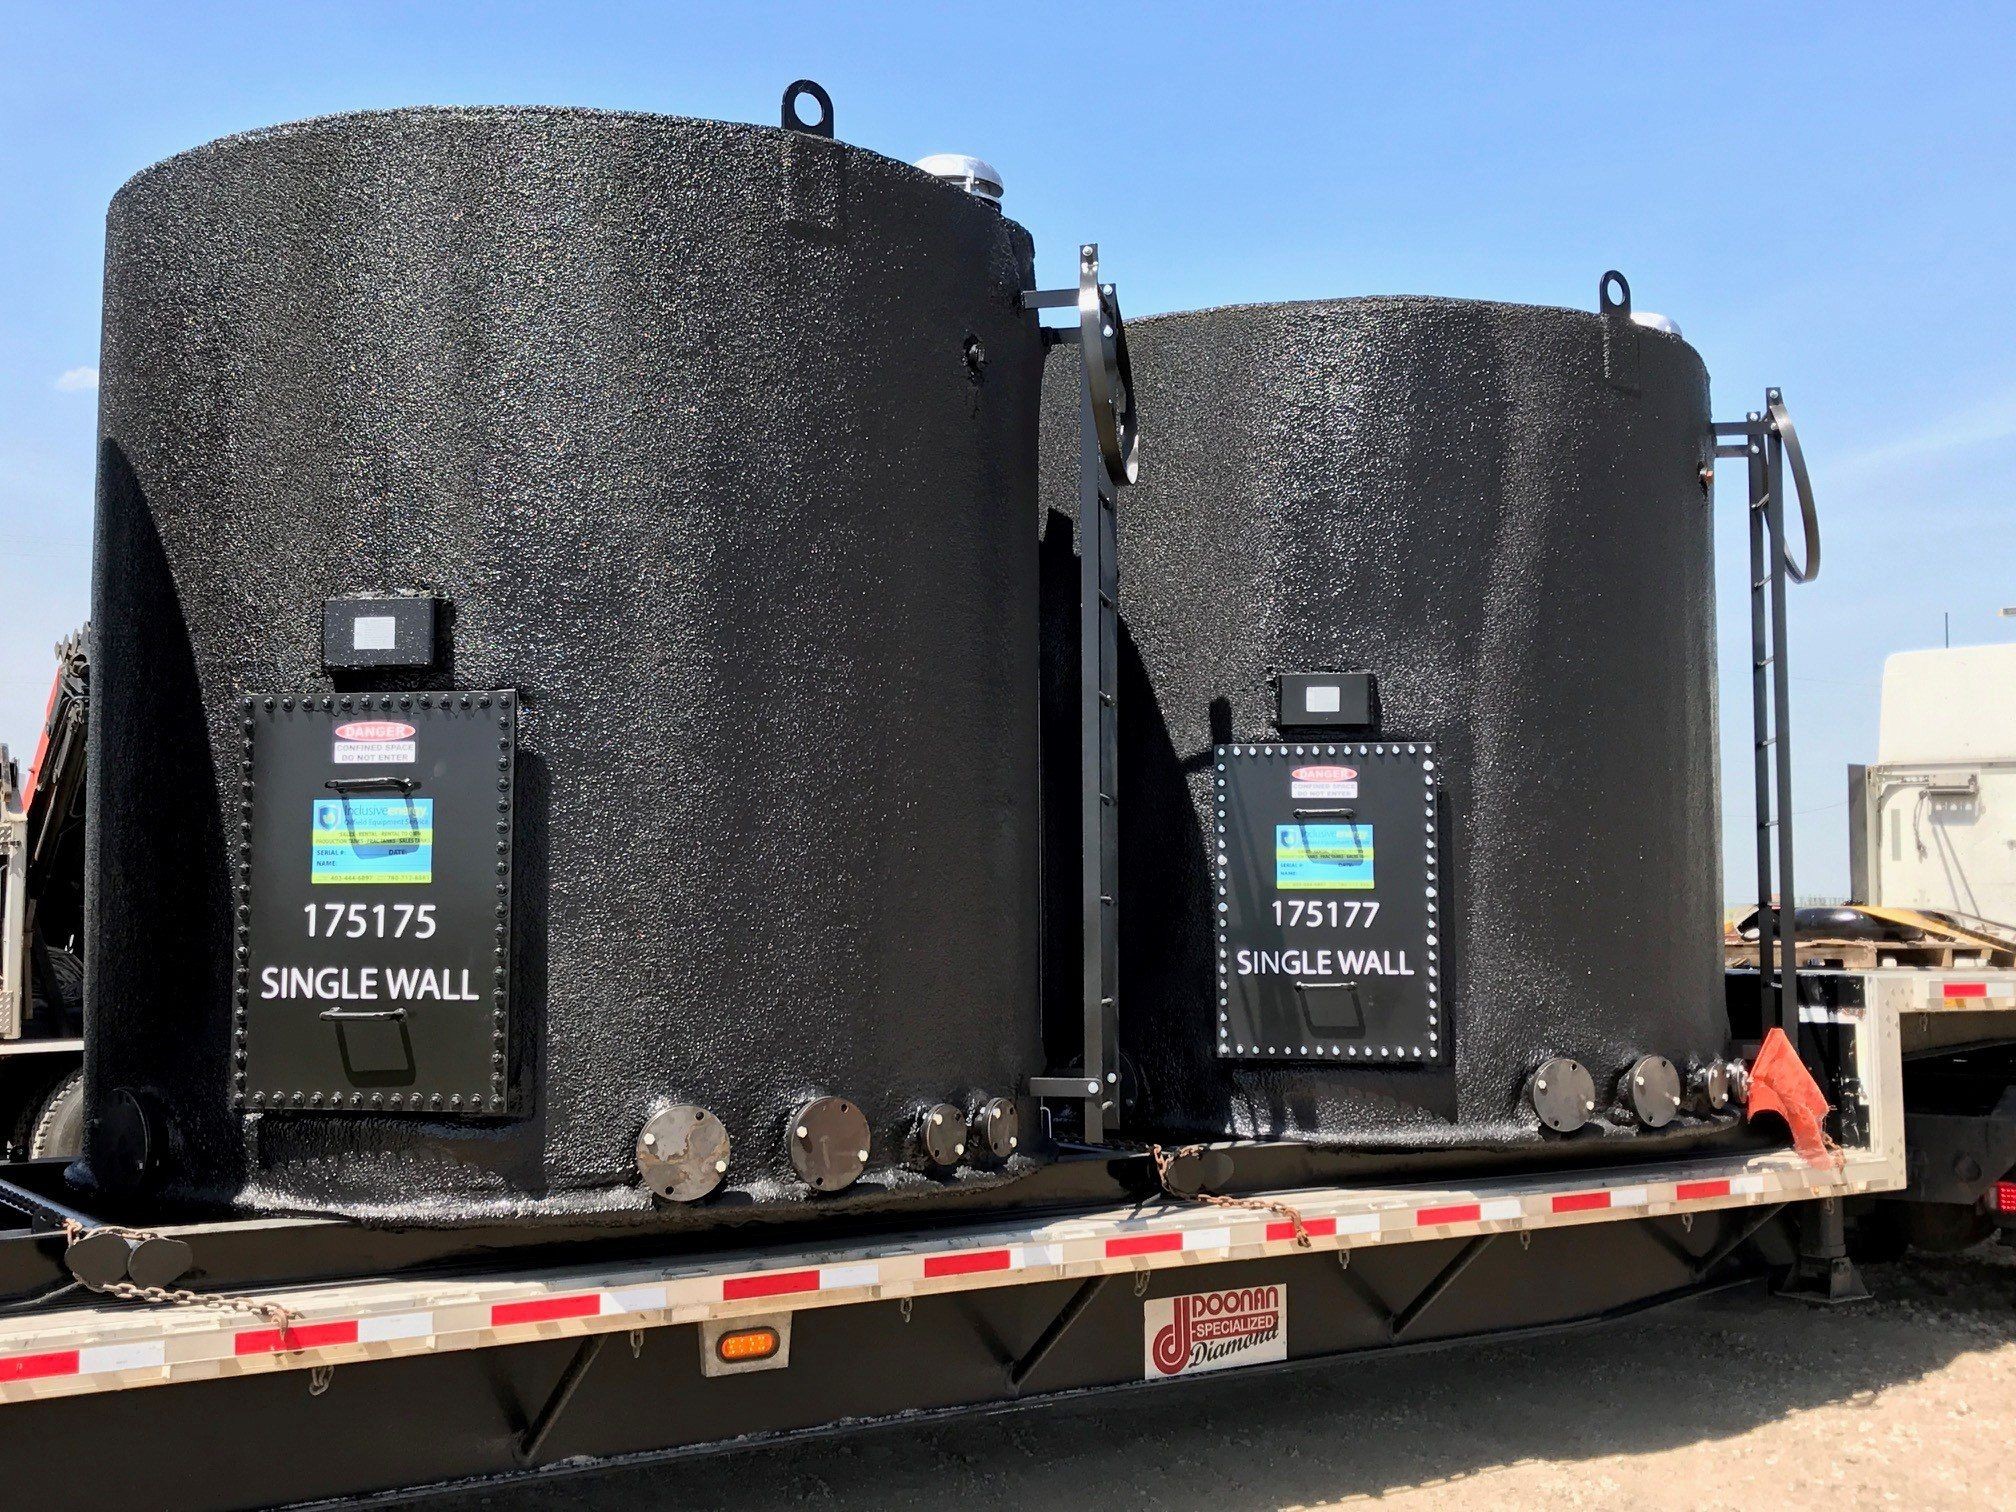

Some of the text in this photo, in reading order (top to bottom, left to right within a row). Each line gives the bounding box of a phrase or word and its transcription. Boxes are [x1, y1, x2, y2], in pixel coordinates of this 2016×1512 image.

[346, 726, 405, 737] DANGER
[1299, 768, 1349, 779] DANGER
[303, 903, 437, 939] 175175
[1271, 900, 1380, 928] 175177
[1236, 950, 1415, 976] SINGLE WALL
[260, 966, 480, 1001] SINGLE WALL
[1192, 1286, 1279, 1319] DOONAN
[1196, 1315, 1274, 1338] SPECIALIZED
